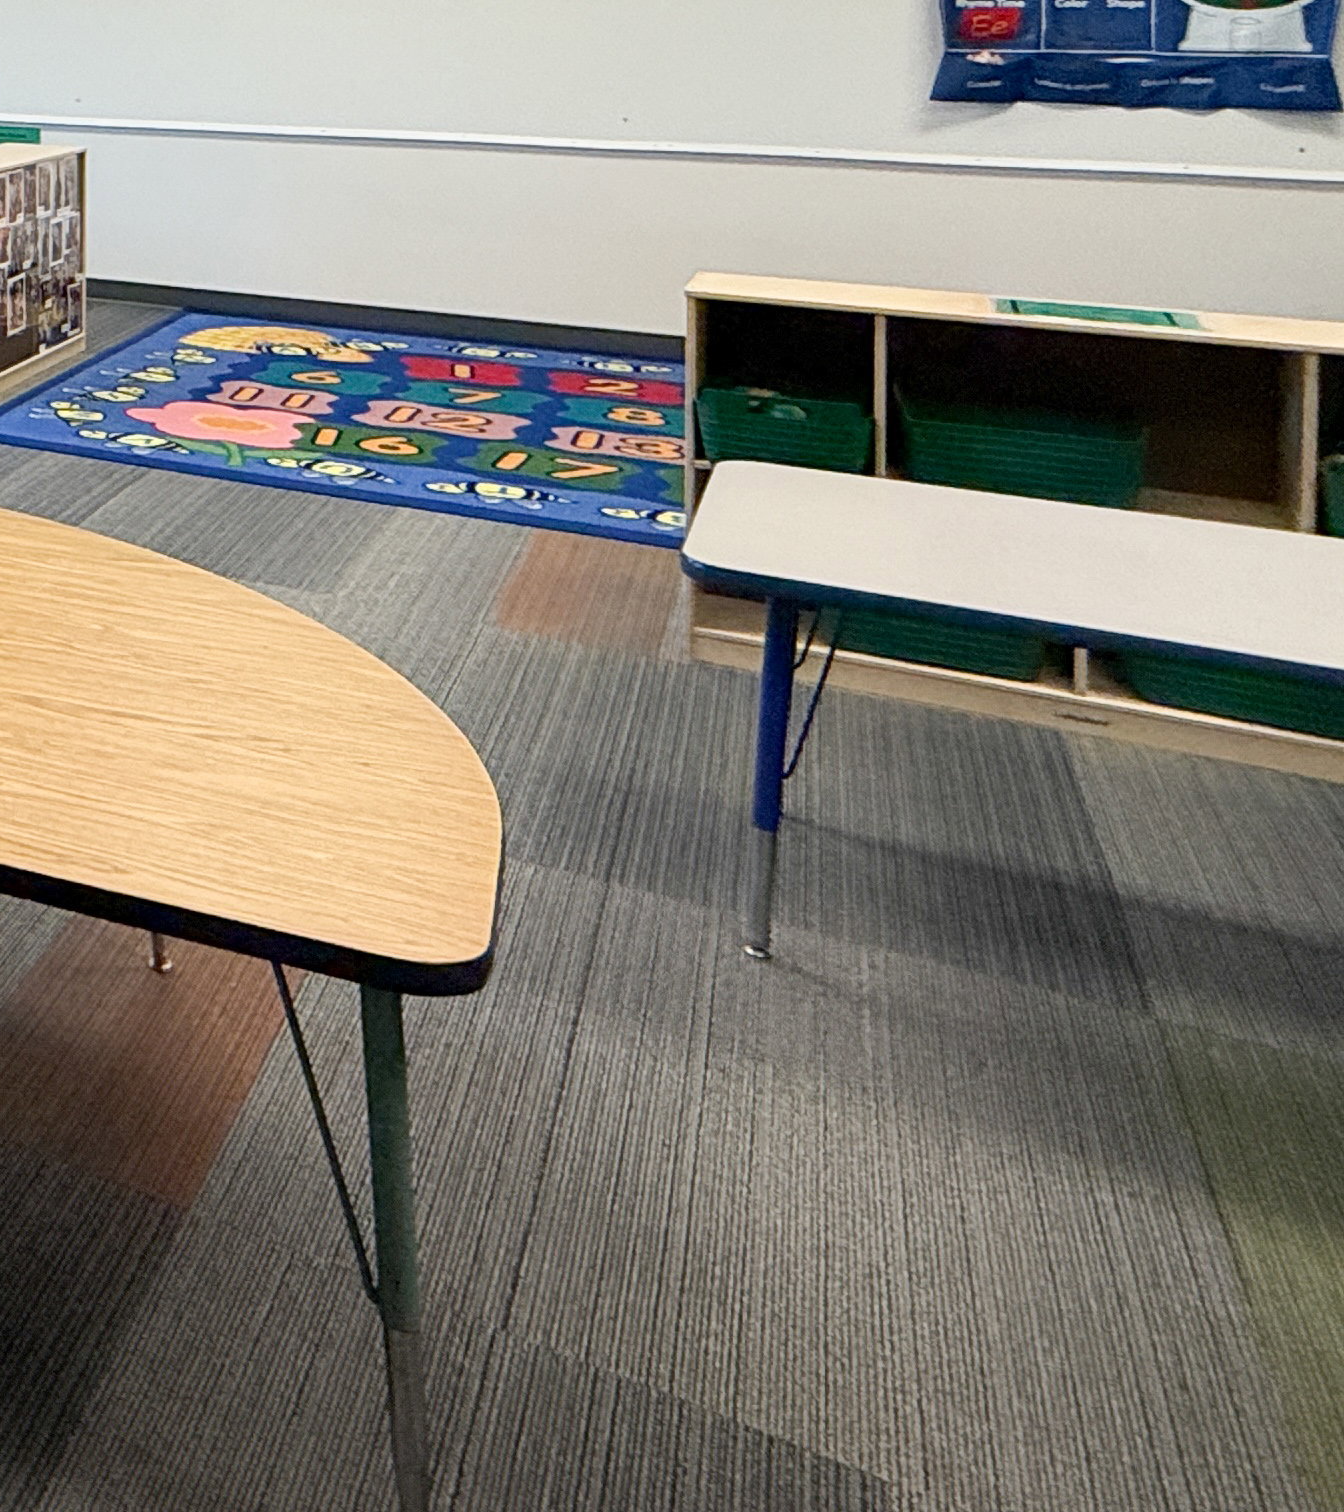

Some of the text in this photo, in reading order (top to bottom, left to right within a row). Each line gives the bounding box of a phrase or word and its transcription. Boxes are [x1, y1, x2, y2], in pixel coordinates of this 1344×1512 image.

[972, 14, 1009, 36] Ee
[290, 369, 343, 385] 6
[451, 363, 475, 379] 1
[229, 386, 315, 409] 11
[448, 387, 502, 405] 7
[583, 378, 643, 397] 2
[384, 406, 492, 434] 12
[606, 406, 667, 426] 8
[312, 427, 423, 455] 16
[571, 429, 685, 460] 13
[491, 450, 623, 479] 17
